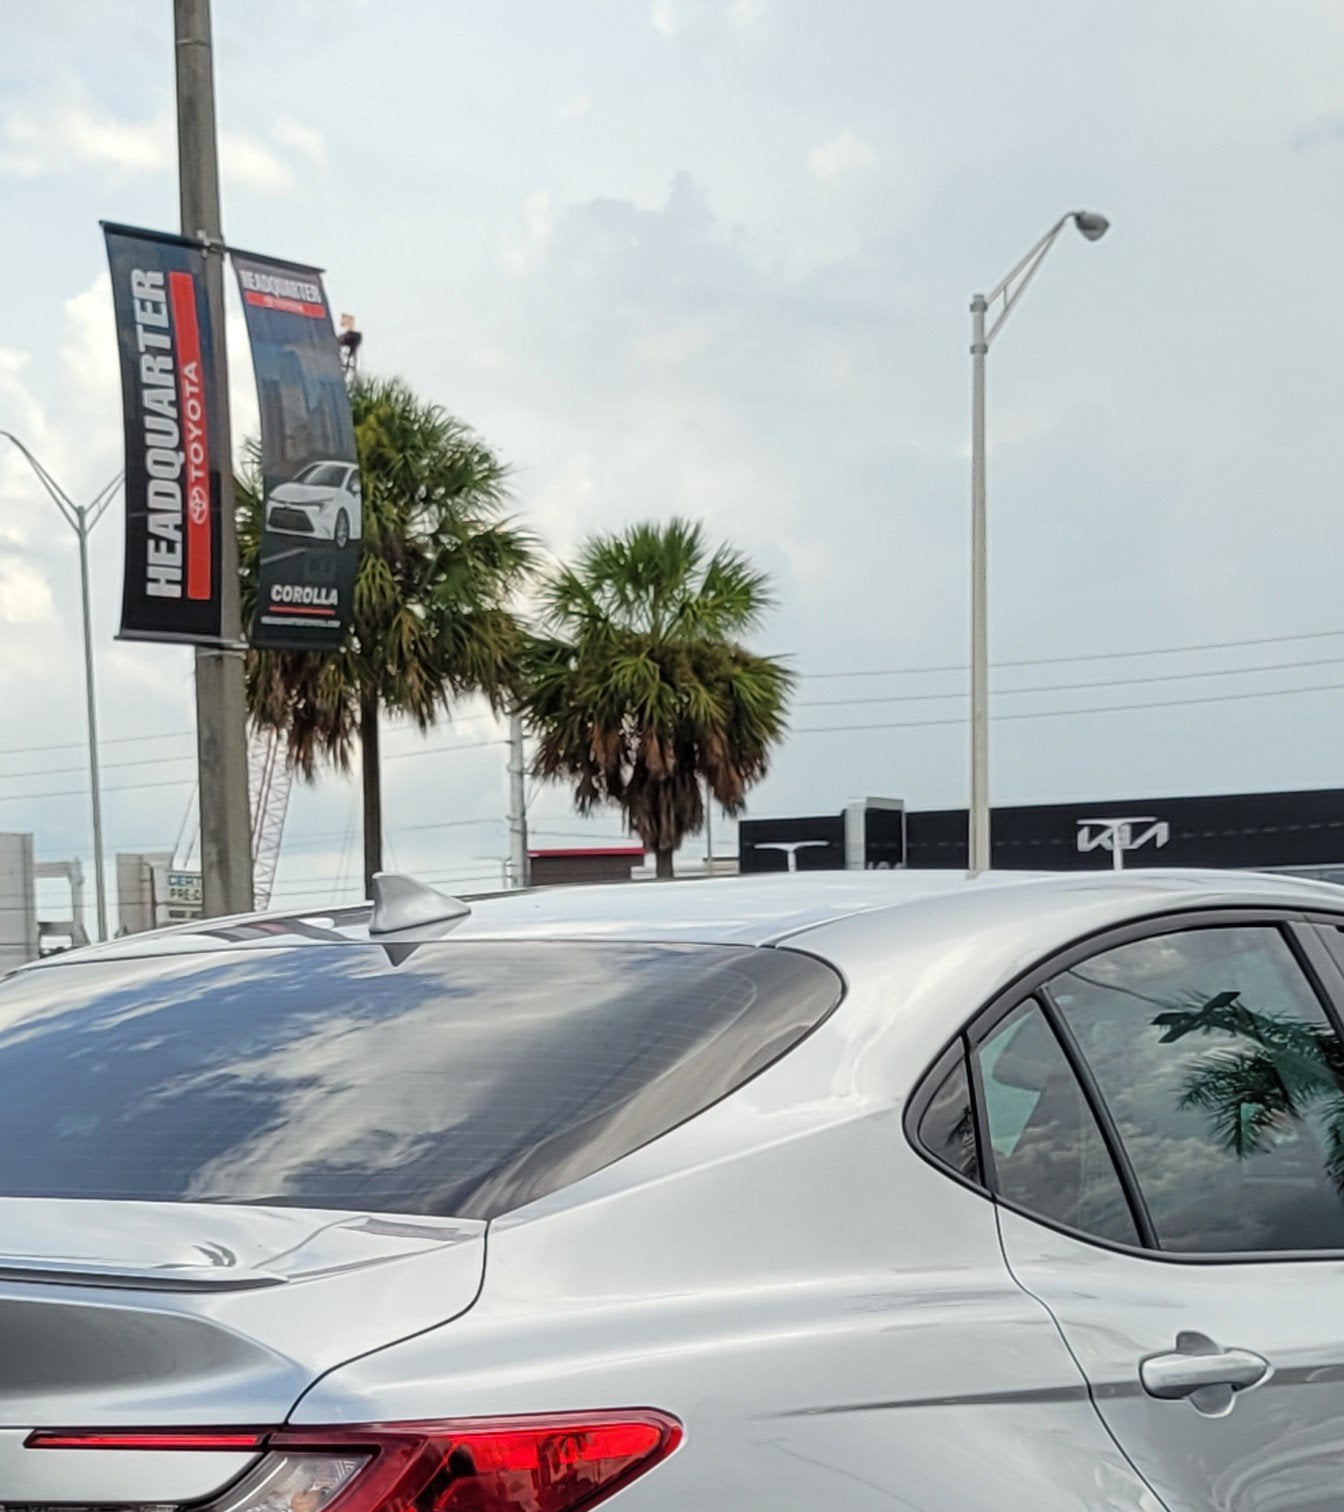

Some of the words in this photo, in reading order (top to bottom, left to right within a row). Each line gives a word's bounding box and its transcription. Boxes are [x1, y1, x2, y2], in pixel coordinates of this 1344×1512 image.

[130, 268, 184, 599] HEADQUARTER
[179, 361, 206, 481] TOYOTA
[270, 584, 338, 606] COROLLA
